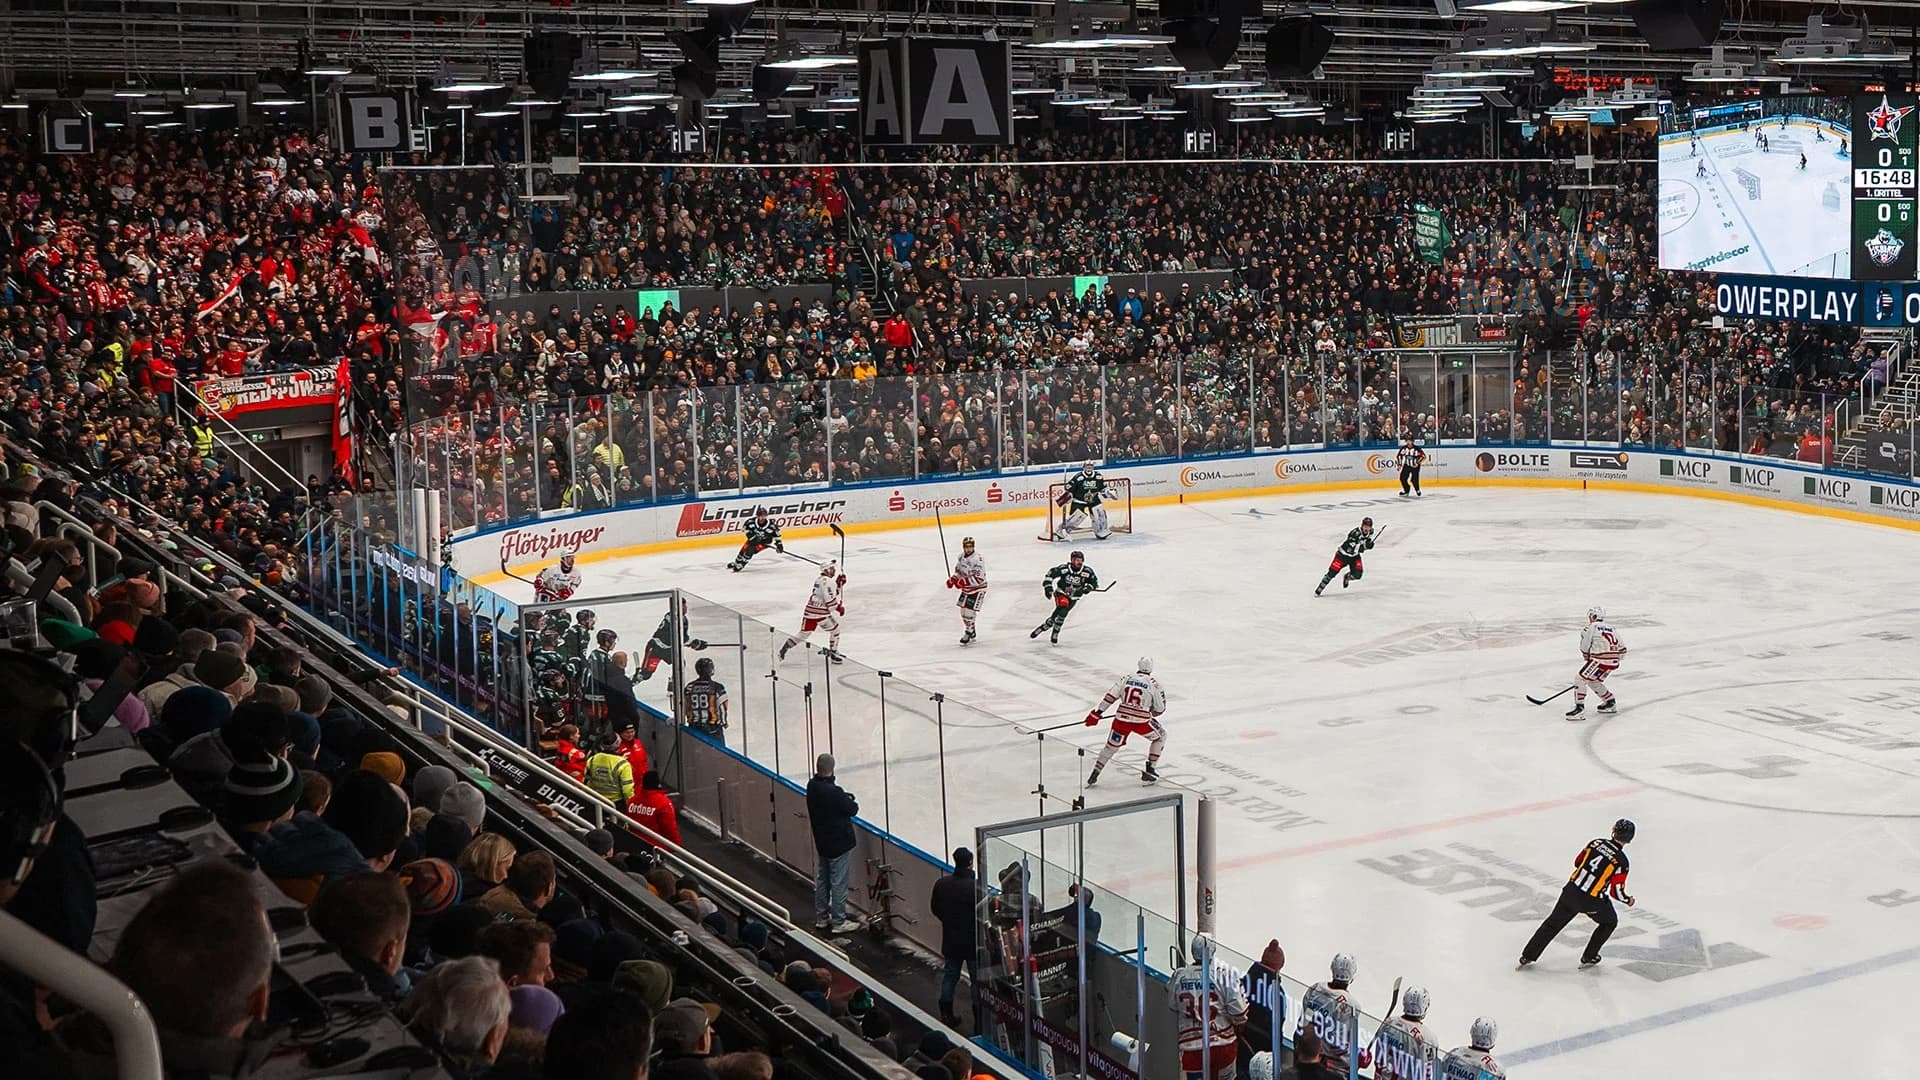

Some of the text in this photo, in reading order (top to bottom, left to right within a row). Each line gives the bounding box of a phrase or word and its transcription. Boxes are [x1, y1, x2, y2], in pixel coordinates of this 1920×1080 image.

[866, 49, 900, 135] A
[919, 48, 1000, 135] A
[350, 97, 400, 149] B
[54, 118, 83, 151] C
[411, 129, 425, 151] E
[684, 130, 699, 151] F
[1199, 132, 1212, 150] F
[1399, 132, 1411, 149] F
[1878, 149, 1892, 167] 0
[1902, 156, 1908, 166] 1
[1861, 170, 1912, 185] 16:48
[1877, 203, 1891, 222] 0
[1900, 211, 1908, 222] 0
[1716, 283, 1858, 322] OWERPLAY
[1285, 464, 1317, 474] ISOMA
[1377, 459, 1402, 468] ISO
[1498, 454, 1550, 466] BOLTE
[1677, 459, 1711, 478] MCP
[1190, 471, 1222, 482] ISOMA
[1744, 468, 1775, 486] MCP
[1819, 479, 1851, 498] MCP
[911, 495, 970, 511] Sparkasse
[1886, 489, 1920, 508] MCP
[726, 511, 844, 533] ELOTECHNIK
[501, 525, 605, 563] Flötzinger
[691, 694, 709, 710] 98
[1124, 686, 1143, 705] 16
[489, 753, 530, 780] CUBE
[537, 783, 585, 817] BLOCK
[628, 802, 656, 817] Ordner
[1588, 854, 1604, 873] 4
[1032, 1017, 1073, 1051] vitagroup
